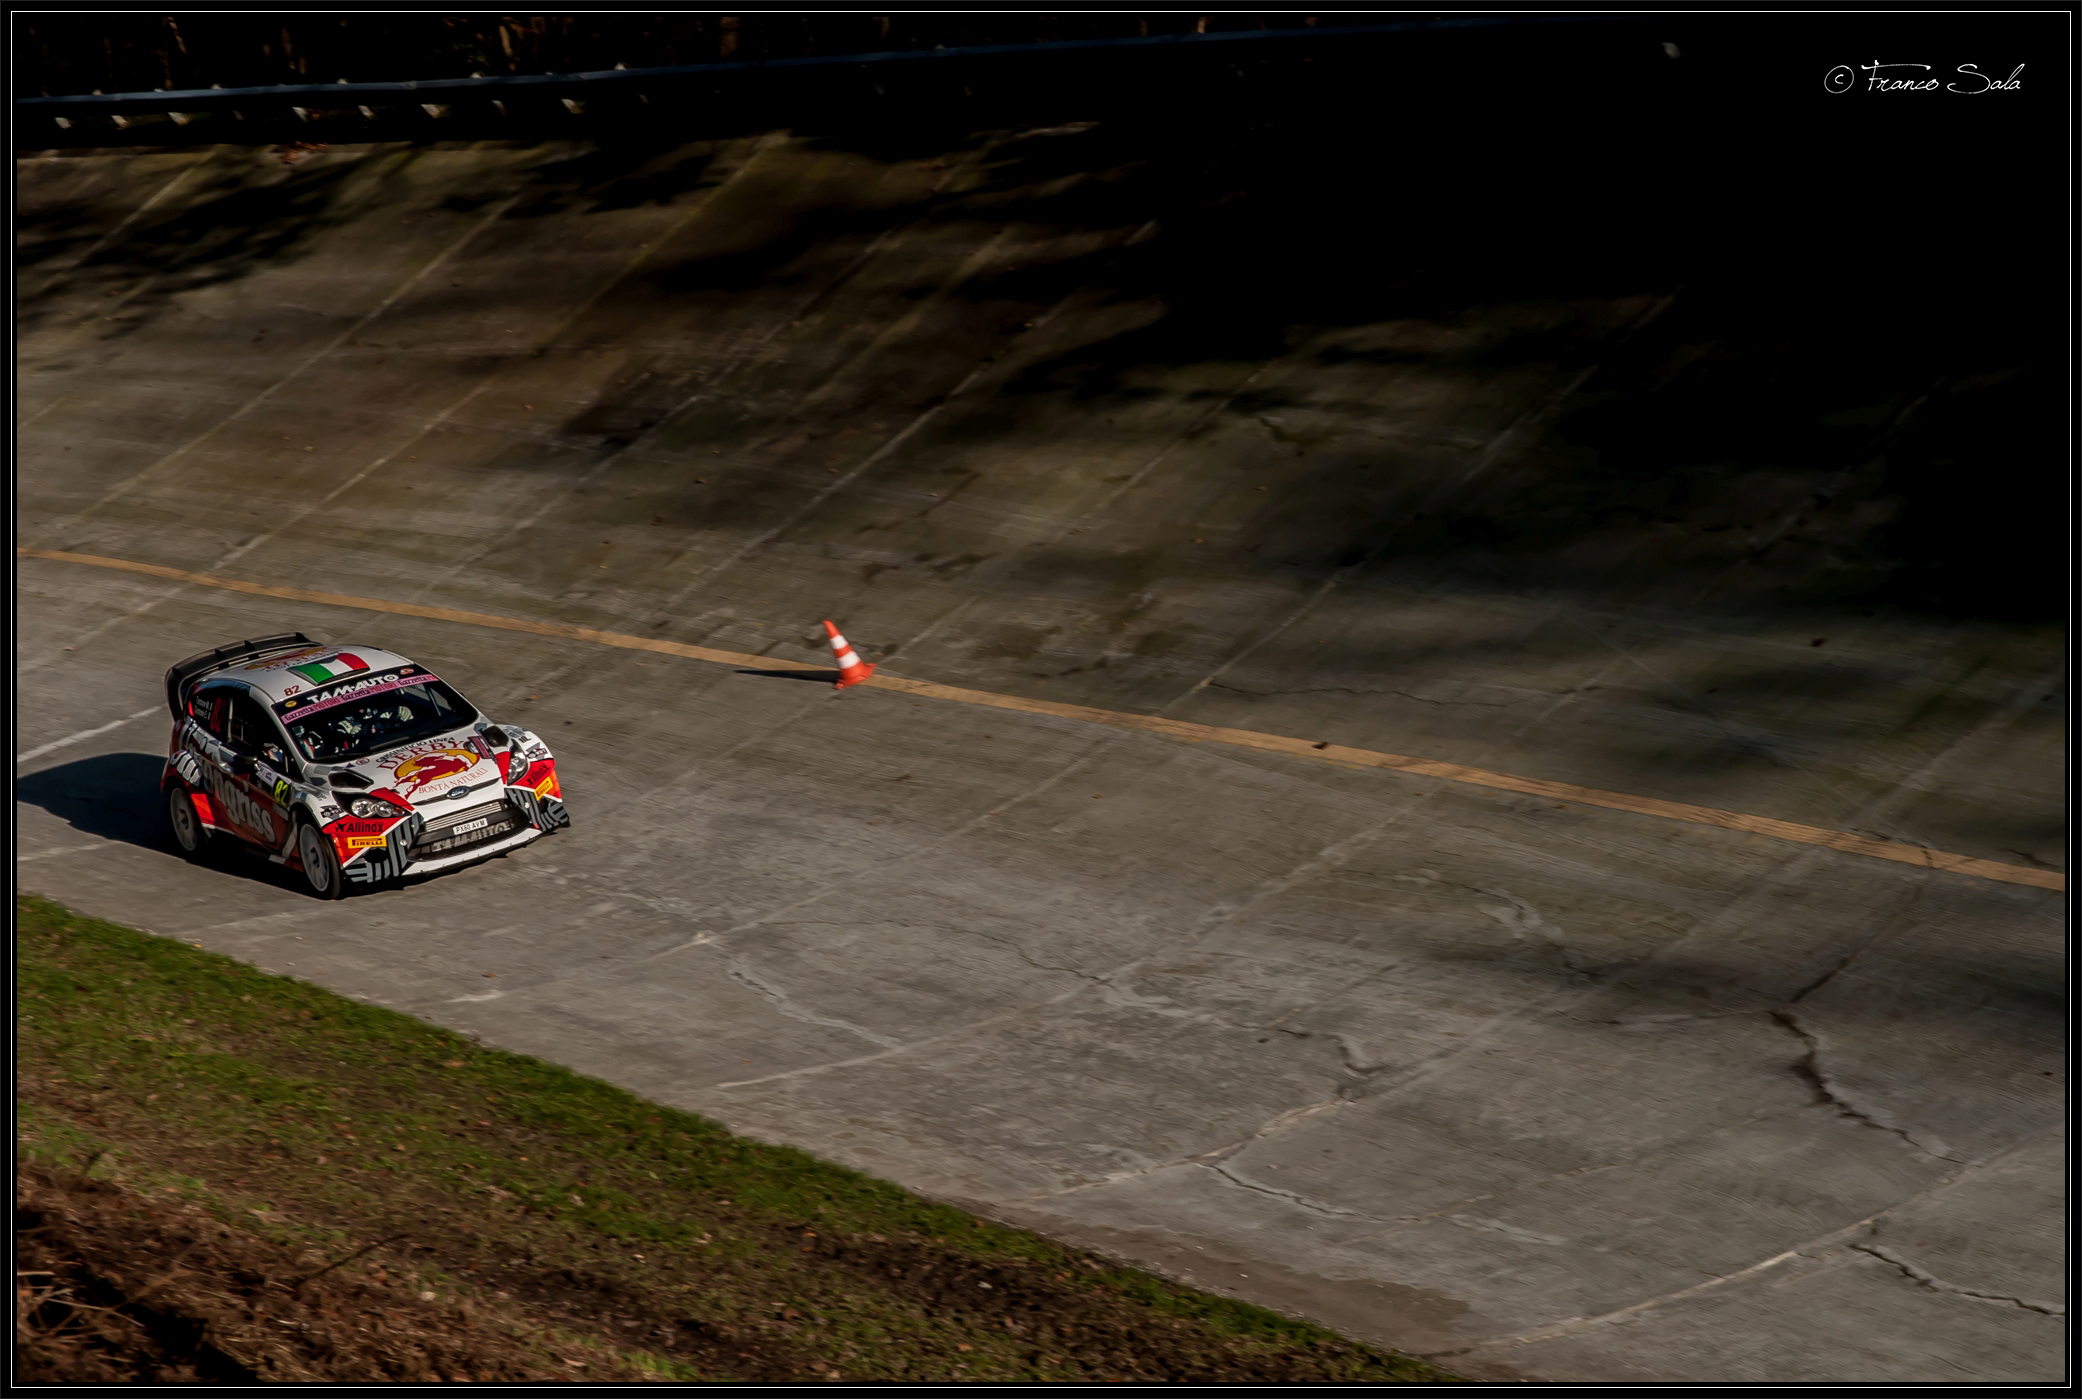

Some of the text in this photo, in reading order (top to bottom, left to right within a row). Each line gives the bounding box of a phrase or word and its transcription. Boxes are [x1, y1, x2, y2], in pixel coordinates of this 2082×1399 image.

[284, 685, 302, 697] 82
[284, 705, 314, 721] Gazzetta
[313, 697, 340, 711] MOTORI
[340, 689, 371, 701] Gazzetta
[370, 682, 396, 694] MOTORI
[397, 676, 427, 686] Gazzetta
[210, 697, 226, 732] 82
[377, 740, 464, 771] DERBY
[274, 780, 289, 807] 82
[418, 767, 489, 794] BONTÀ NATURALI
[345, 821, 384, 832] Allinox
[455, 819, 485, 833] PX60 AVM
[351, 837, 383, 846] PIRELLI
